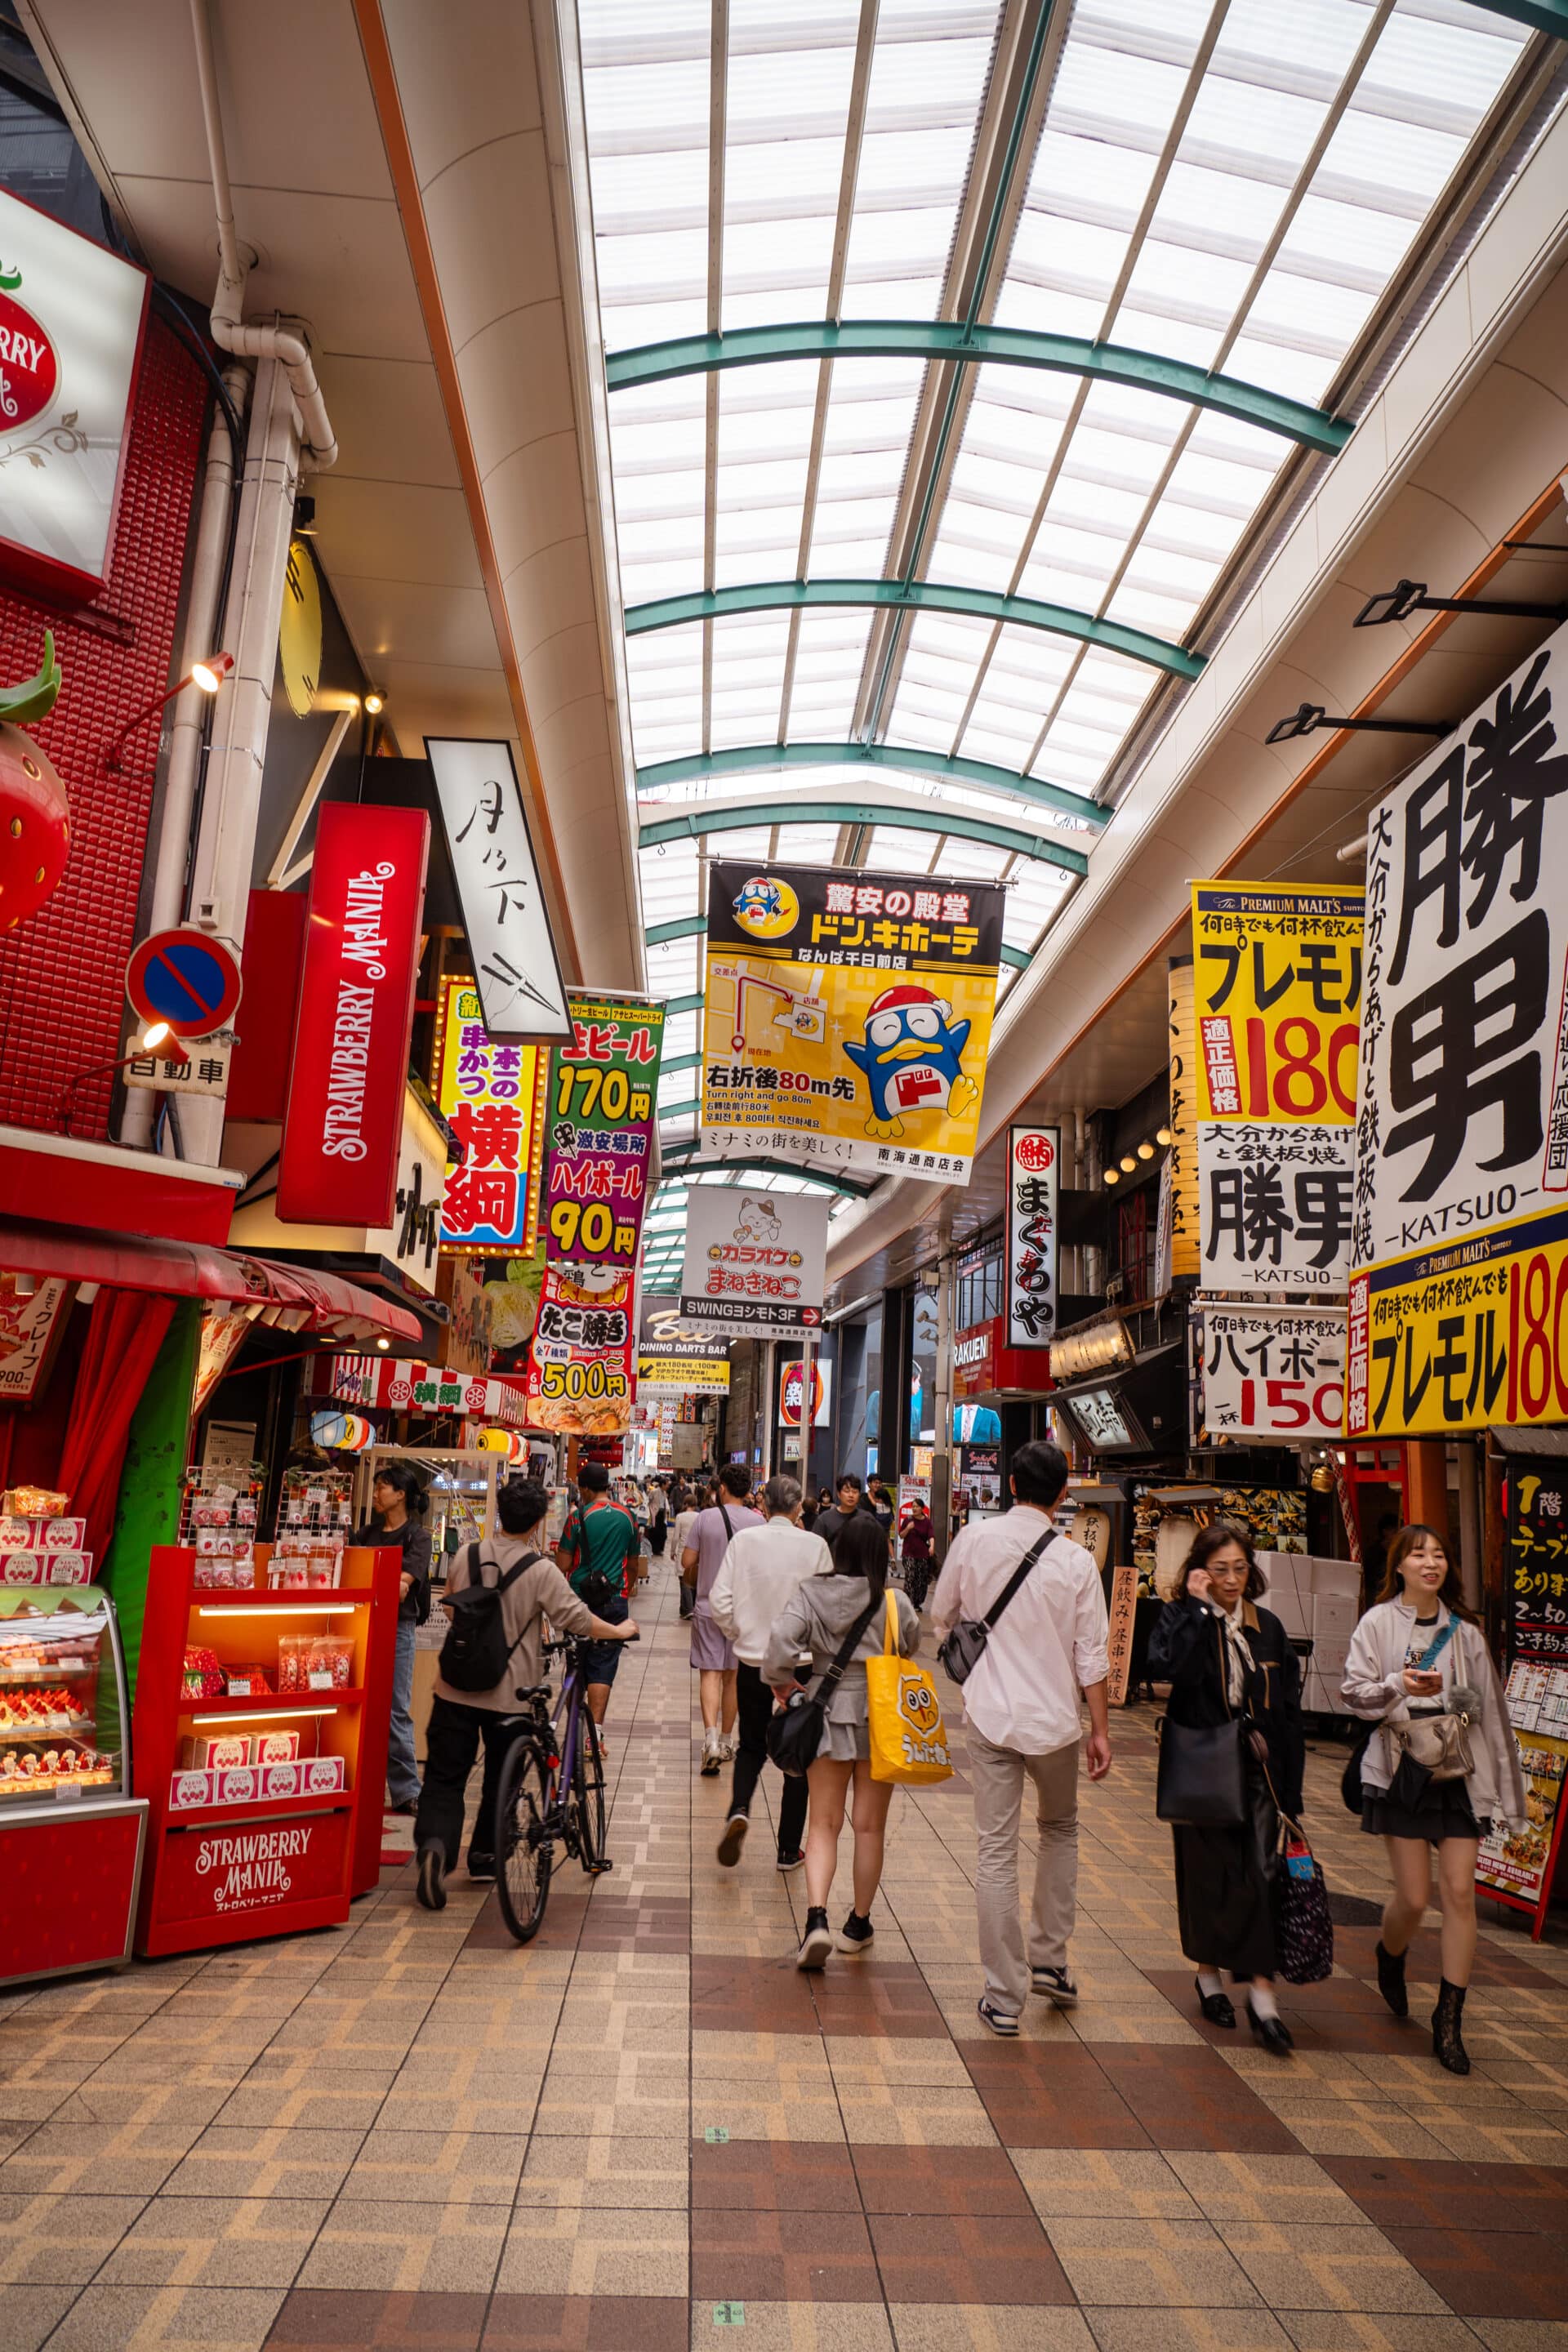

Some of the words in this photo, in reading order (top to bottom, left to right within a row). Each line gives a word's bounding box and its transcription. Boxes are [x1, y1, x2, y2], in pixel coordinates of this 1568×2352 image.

[341, 862, 396, 980] MANIA
[826, 883, 970, 923] 驚安の殿堂
[1214, 897, 1240, 910] The
[1241, 897, 1294, 912] PREMIUM
[1298, 898, 1341, 914] MALT'S
[1382, 650, 1568, 1203] 勝男
[798, 947, 907, 970] なんば千日前店
[613, 1009, 662, 1022] アサヒスーパードライ
[1352, 808, 1393, 1269] 大分からあげと鉄板焼
[130, 1050, 225, 1085] 自動車
[322, 979, 375, 1162] STRAWBERRY
[457, 1024, 489, 1096] 串かつ
[1203, 1018, 1240, 1112] 適正価格
[557, 1065, 651, 1123] 170円
[706, 1065, 856, 1102] 右折後80m先
[706, 1090, 728, 1098] Turn
[730, 1091, 754, 1101] right
[756, 1092, 774, 1100] and
[777, 1094, 789, 1102] go
[791, 1095, 812, 1104] 80m
[733, 1113, 742, 1122] 후
[745, 1115, 775, 1124] 80미터
[777, 1115, 820, 1128] 직진하세요
[1204, 1124, 1356, 1143] 大分からあげ
[441, 1102, 523, 1236] 横綱
[878, 1147, 964, 1173] 南海通商店会
[1216, 1143, 1346, 1165] と鉄板焼
[551, 1160, 644, 1200] ハイボール
[549, 1198, 636, 1257] 90円
[721, 1244, 790, 1267] カラオケ
[1428, 1252, 1461, 1274] PREMIUM
[1462, 1236, 1490, 1264] MALT'S
[705, 1265, 802, 1300] まねきねこ
[1373, 1265, 1508, 1326] 何時でも何杯飲んでも
[541, 1306, 624, 1347] たこ焼き
[686, 1301, 797, 1321] SWINGヨシモト3F
[639, 1343, 673, 1353] DINING
[675, 1343, 706, 1354] DARTS
[708, 1345, 727, 1355] BAR
[1207, 1334, 1345, 1380] ハイボー
[1348, 1278, 1369, 1431] 適正価格
[1372, 1310, 1508, 1433] プレモル
[412, 1381, 463, 1406] 横綱
[1214, 1402, 1240, 1426] 一杯
[1517, 1475, 1562, 1517] 1階
[1510, 1524, 1568, 1560] テーブ
[1514, 1566, 1568, 1597] ありま
[196, 1828, 312, 1874] STRAWBERRY
[214, 1859, 292, 1903] MANIA
[216, 1893, 285, 1912] ストロベリーマニア
